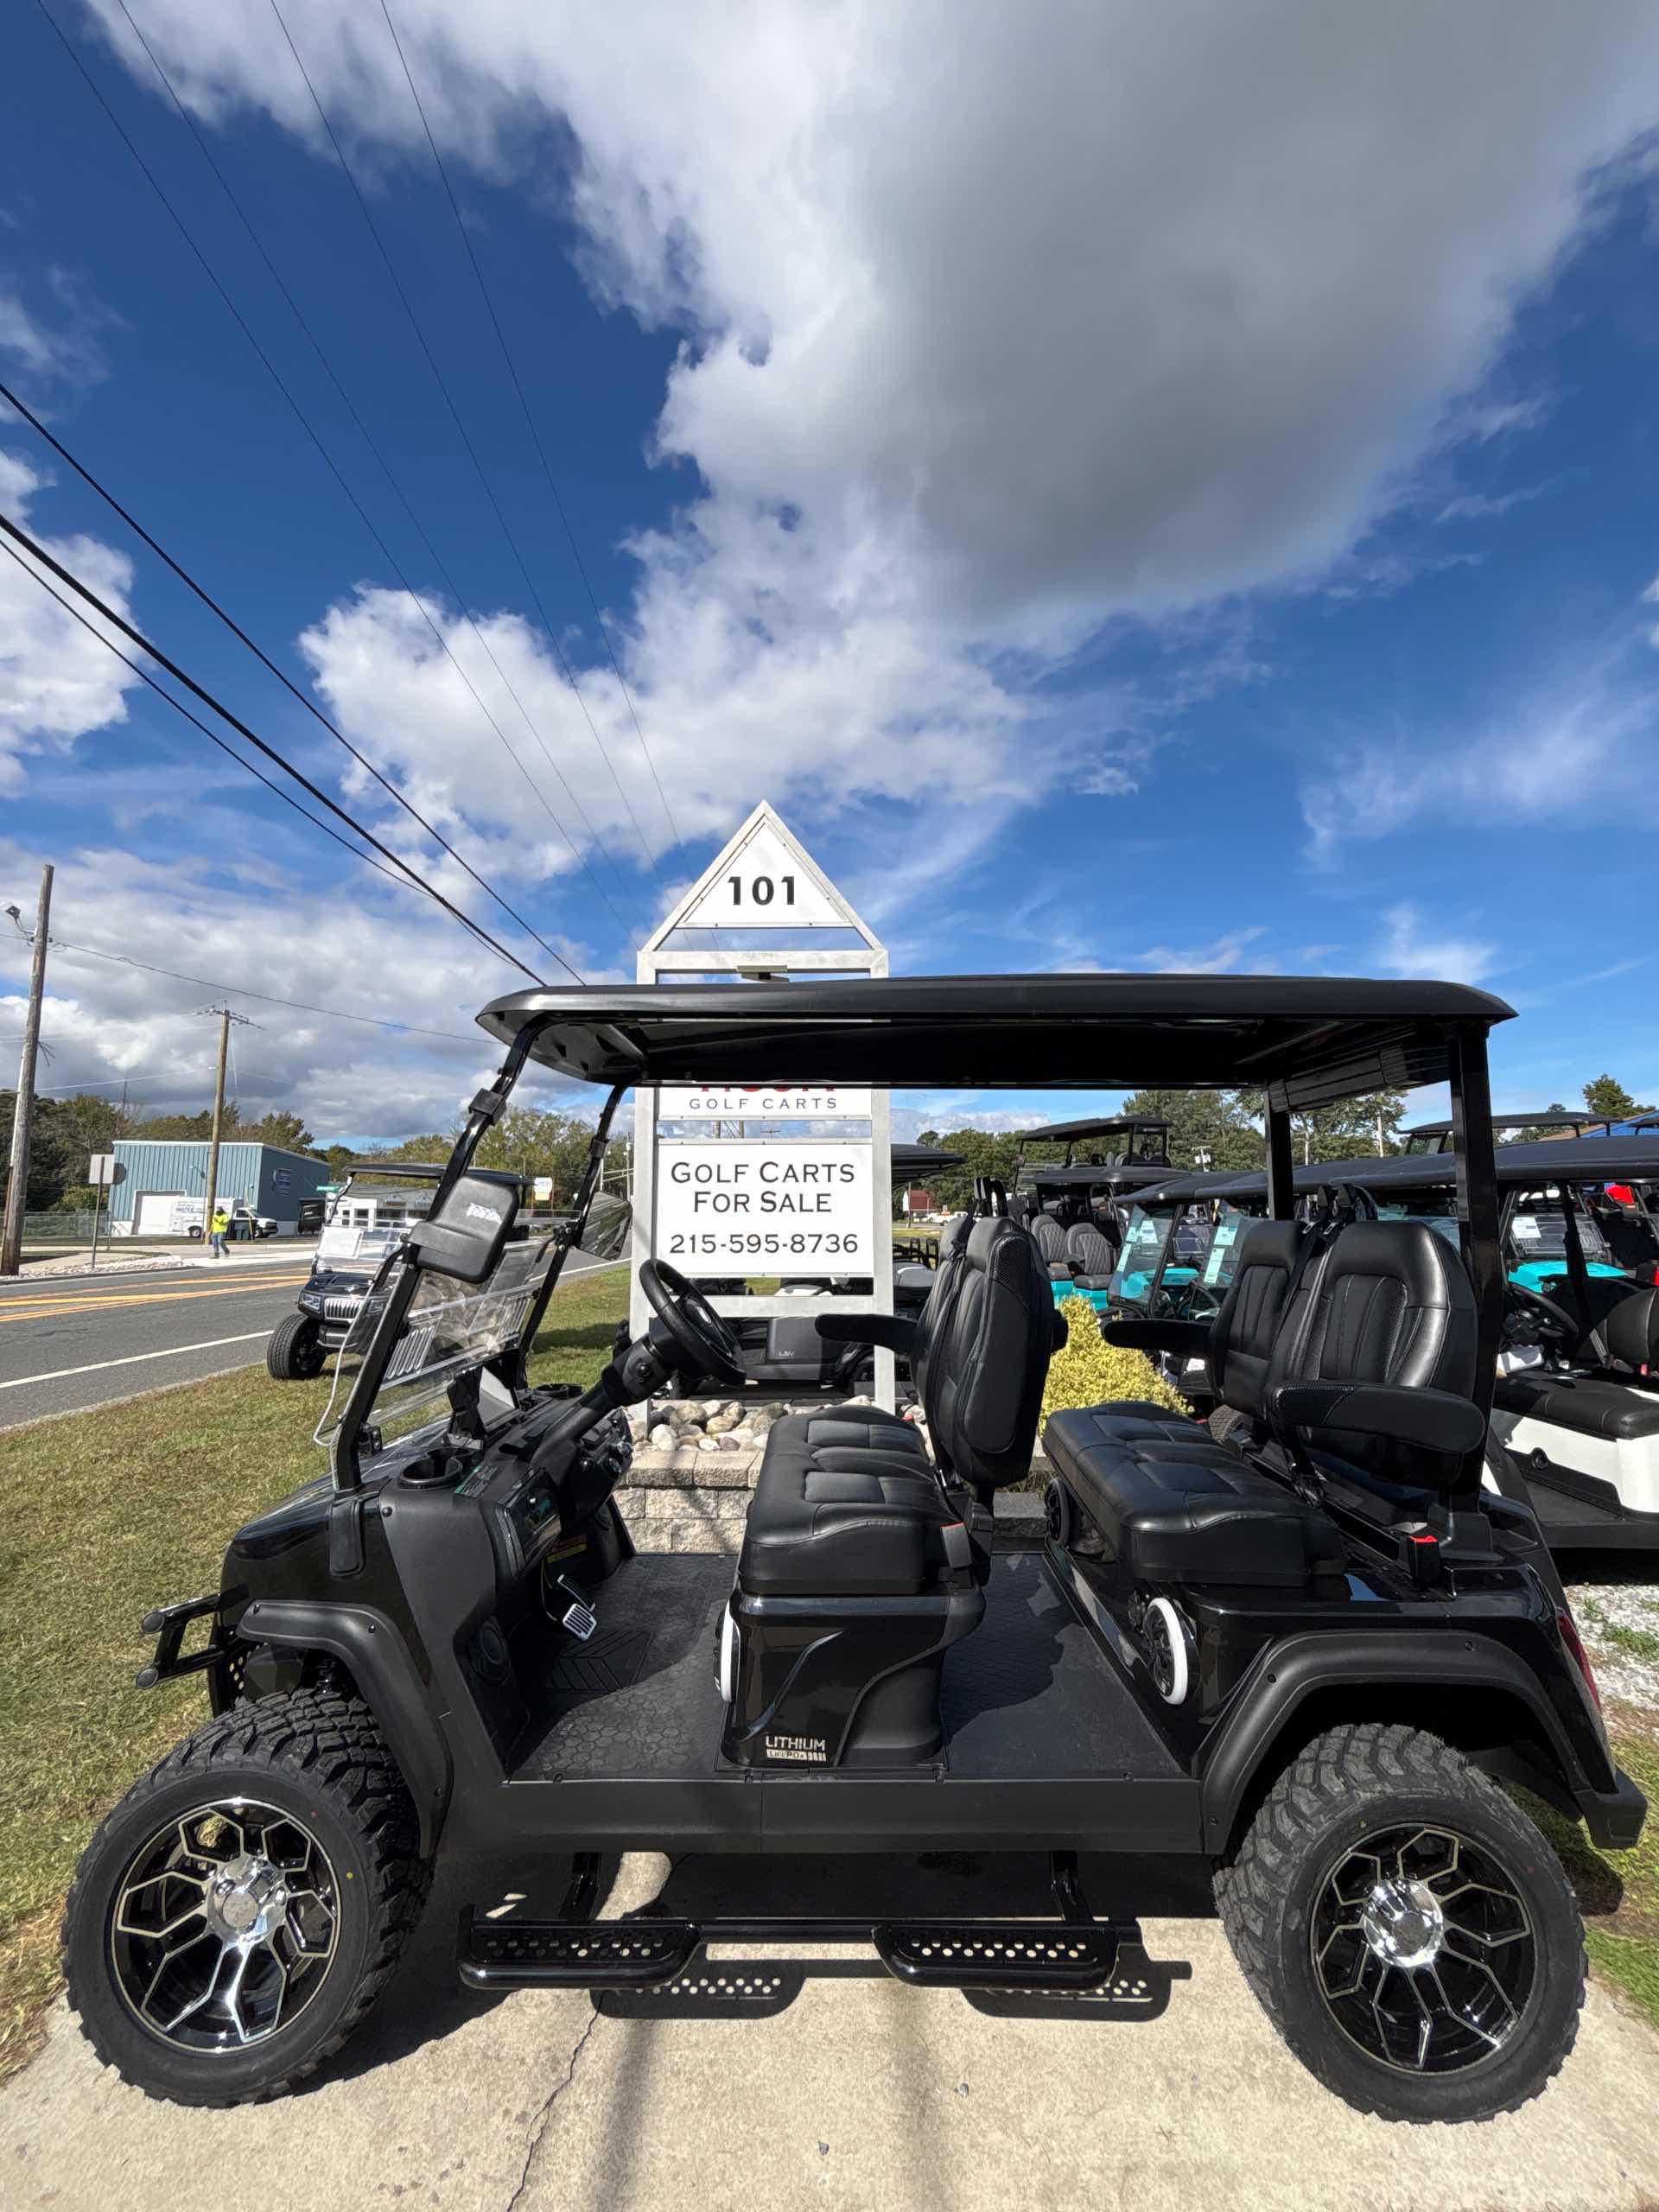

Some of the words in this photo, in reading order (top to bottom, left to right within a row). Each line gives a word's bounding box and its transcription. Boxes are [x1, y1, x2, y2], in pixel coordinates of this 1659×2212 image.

[728, 875, 795, 906] 101
[689, 1098, 749, 1109] GOLF
[762, 1097, 837, 1109] CARTS
[671, 1161, 750, 1184] GOLF
[759, 1160, 855, 1183] CARTS
[693, 1191, 750, 1213] FOR
[760, 1190, 832, 1213] SALE
[670, 1233, 859, 1254] 215-595-8736
[765, 1734, 826, 1751] LITHIUM
